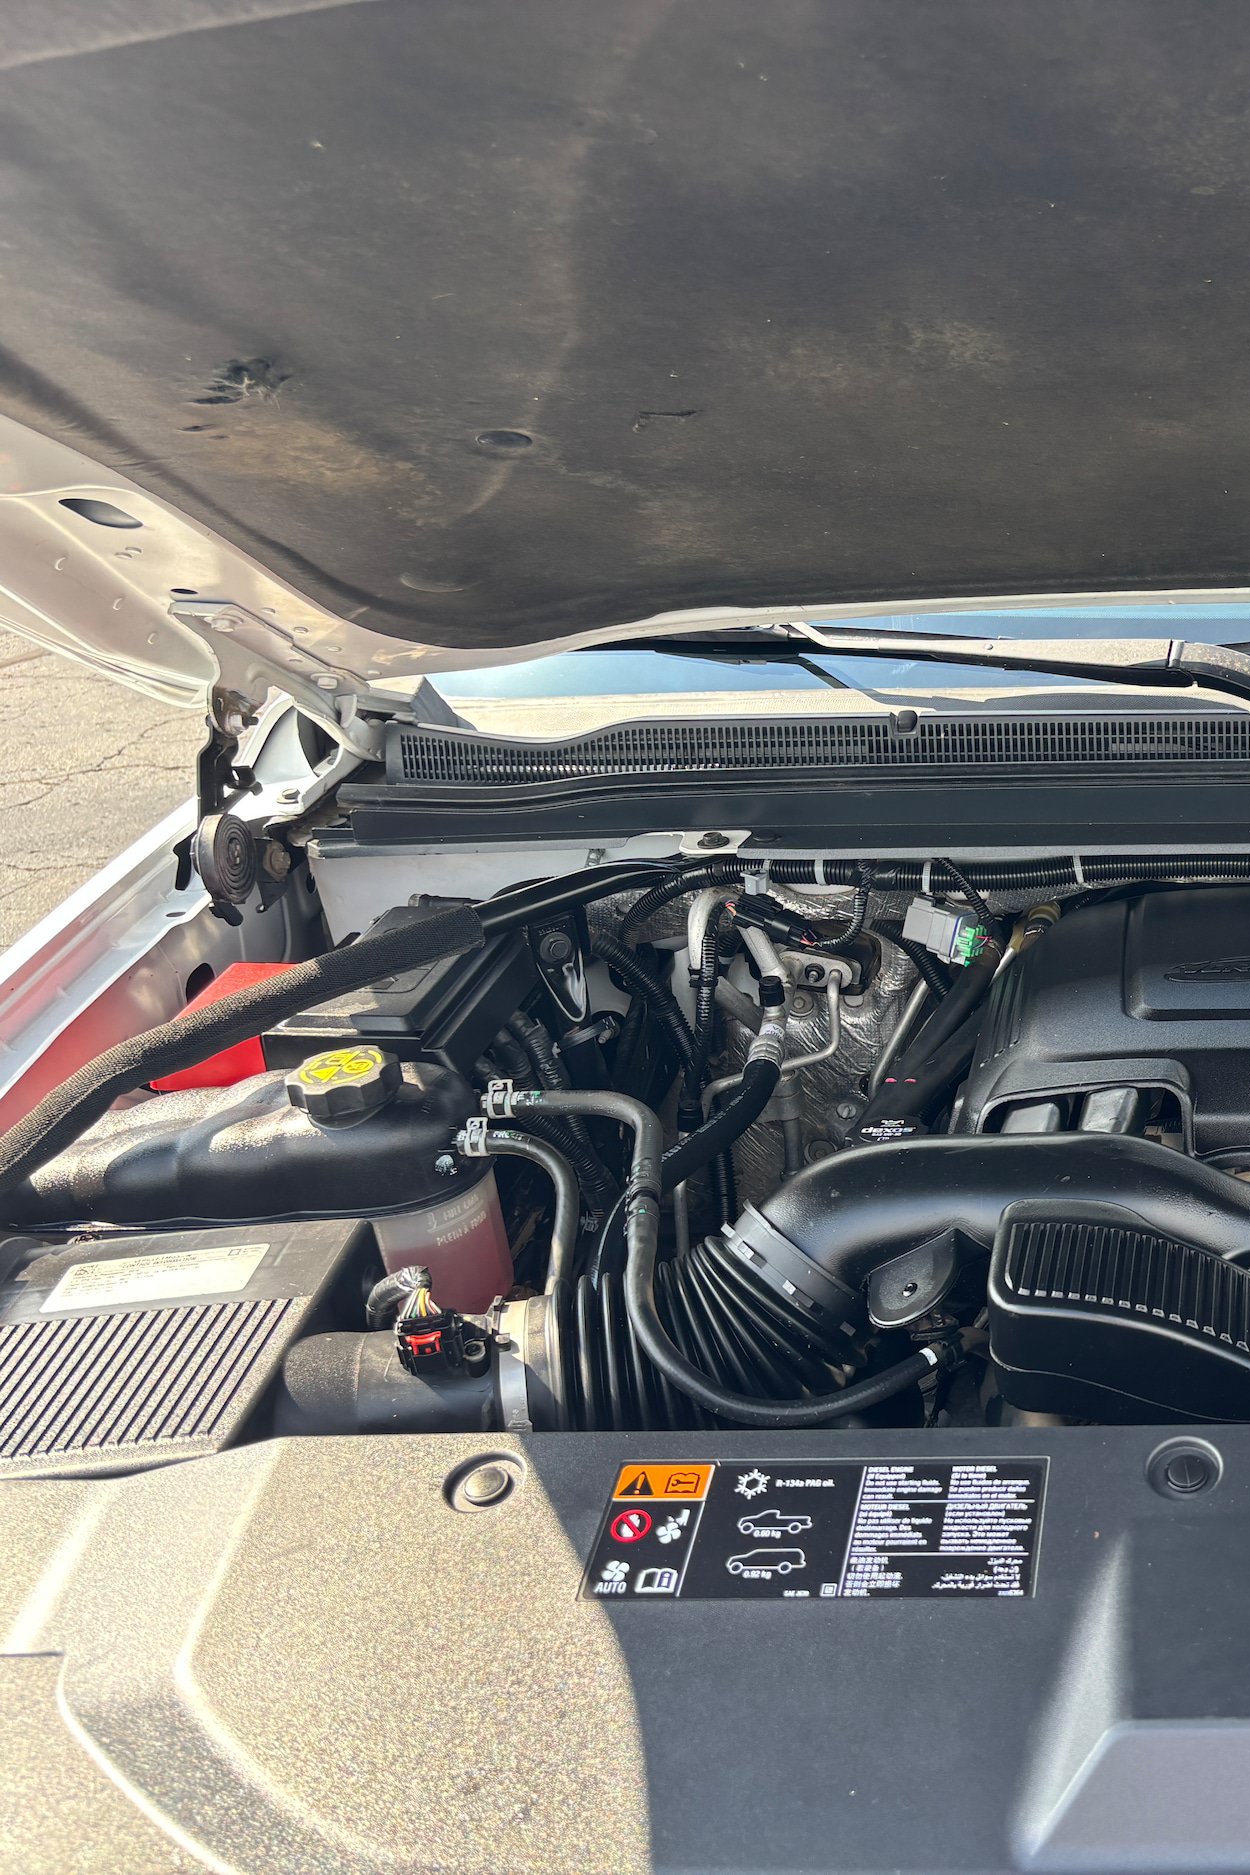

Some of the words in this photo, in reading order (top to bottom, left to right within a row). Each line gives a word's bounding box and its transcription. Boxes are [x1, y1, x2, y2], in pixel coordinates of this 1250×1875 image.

[753, 1530, 770, 1538] 0.60
[771, 1530, 781, 1538] kg
[743, 1570, 760, 1578] 0.92
[761, 1570, 772, 1579] kg
[593, 1582, 626, 1593] AUTO
